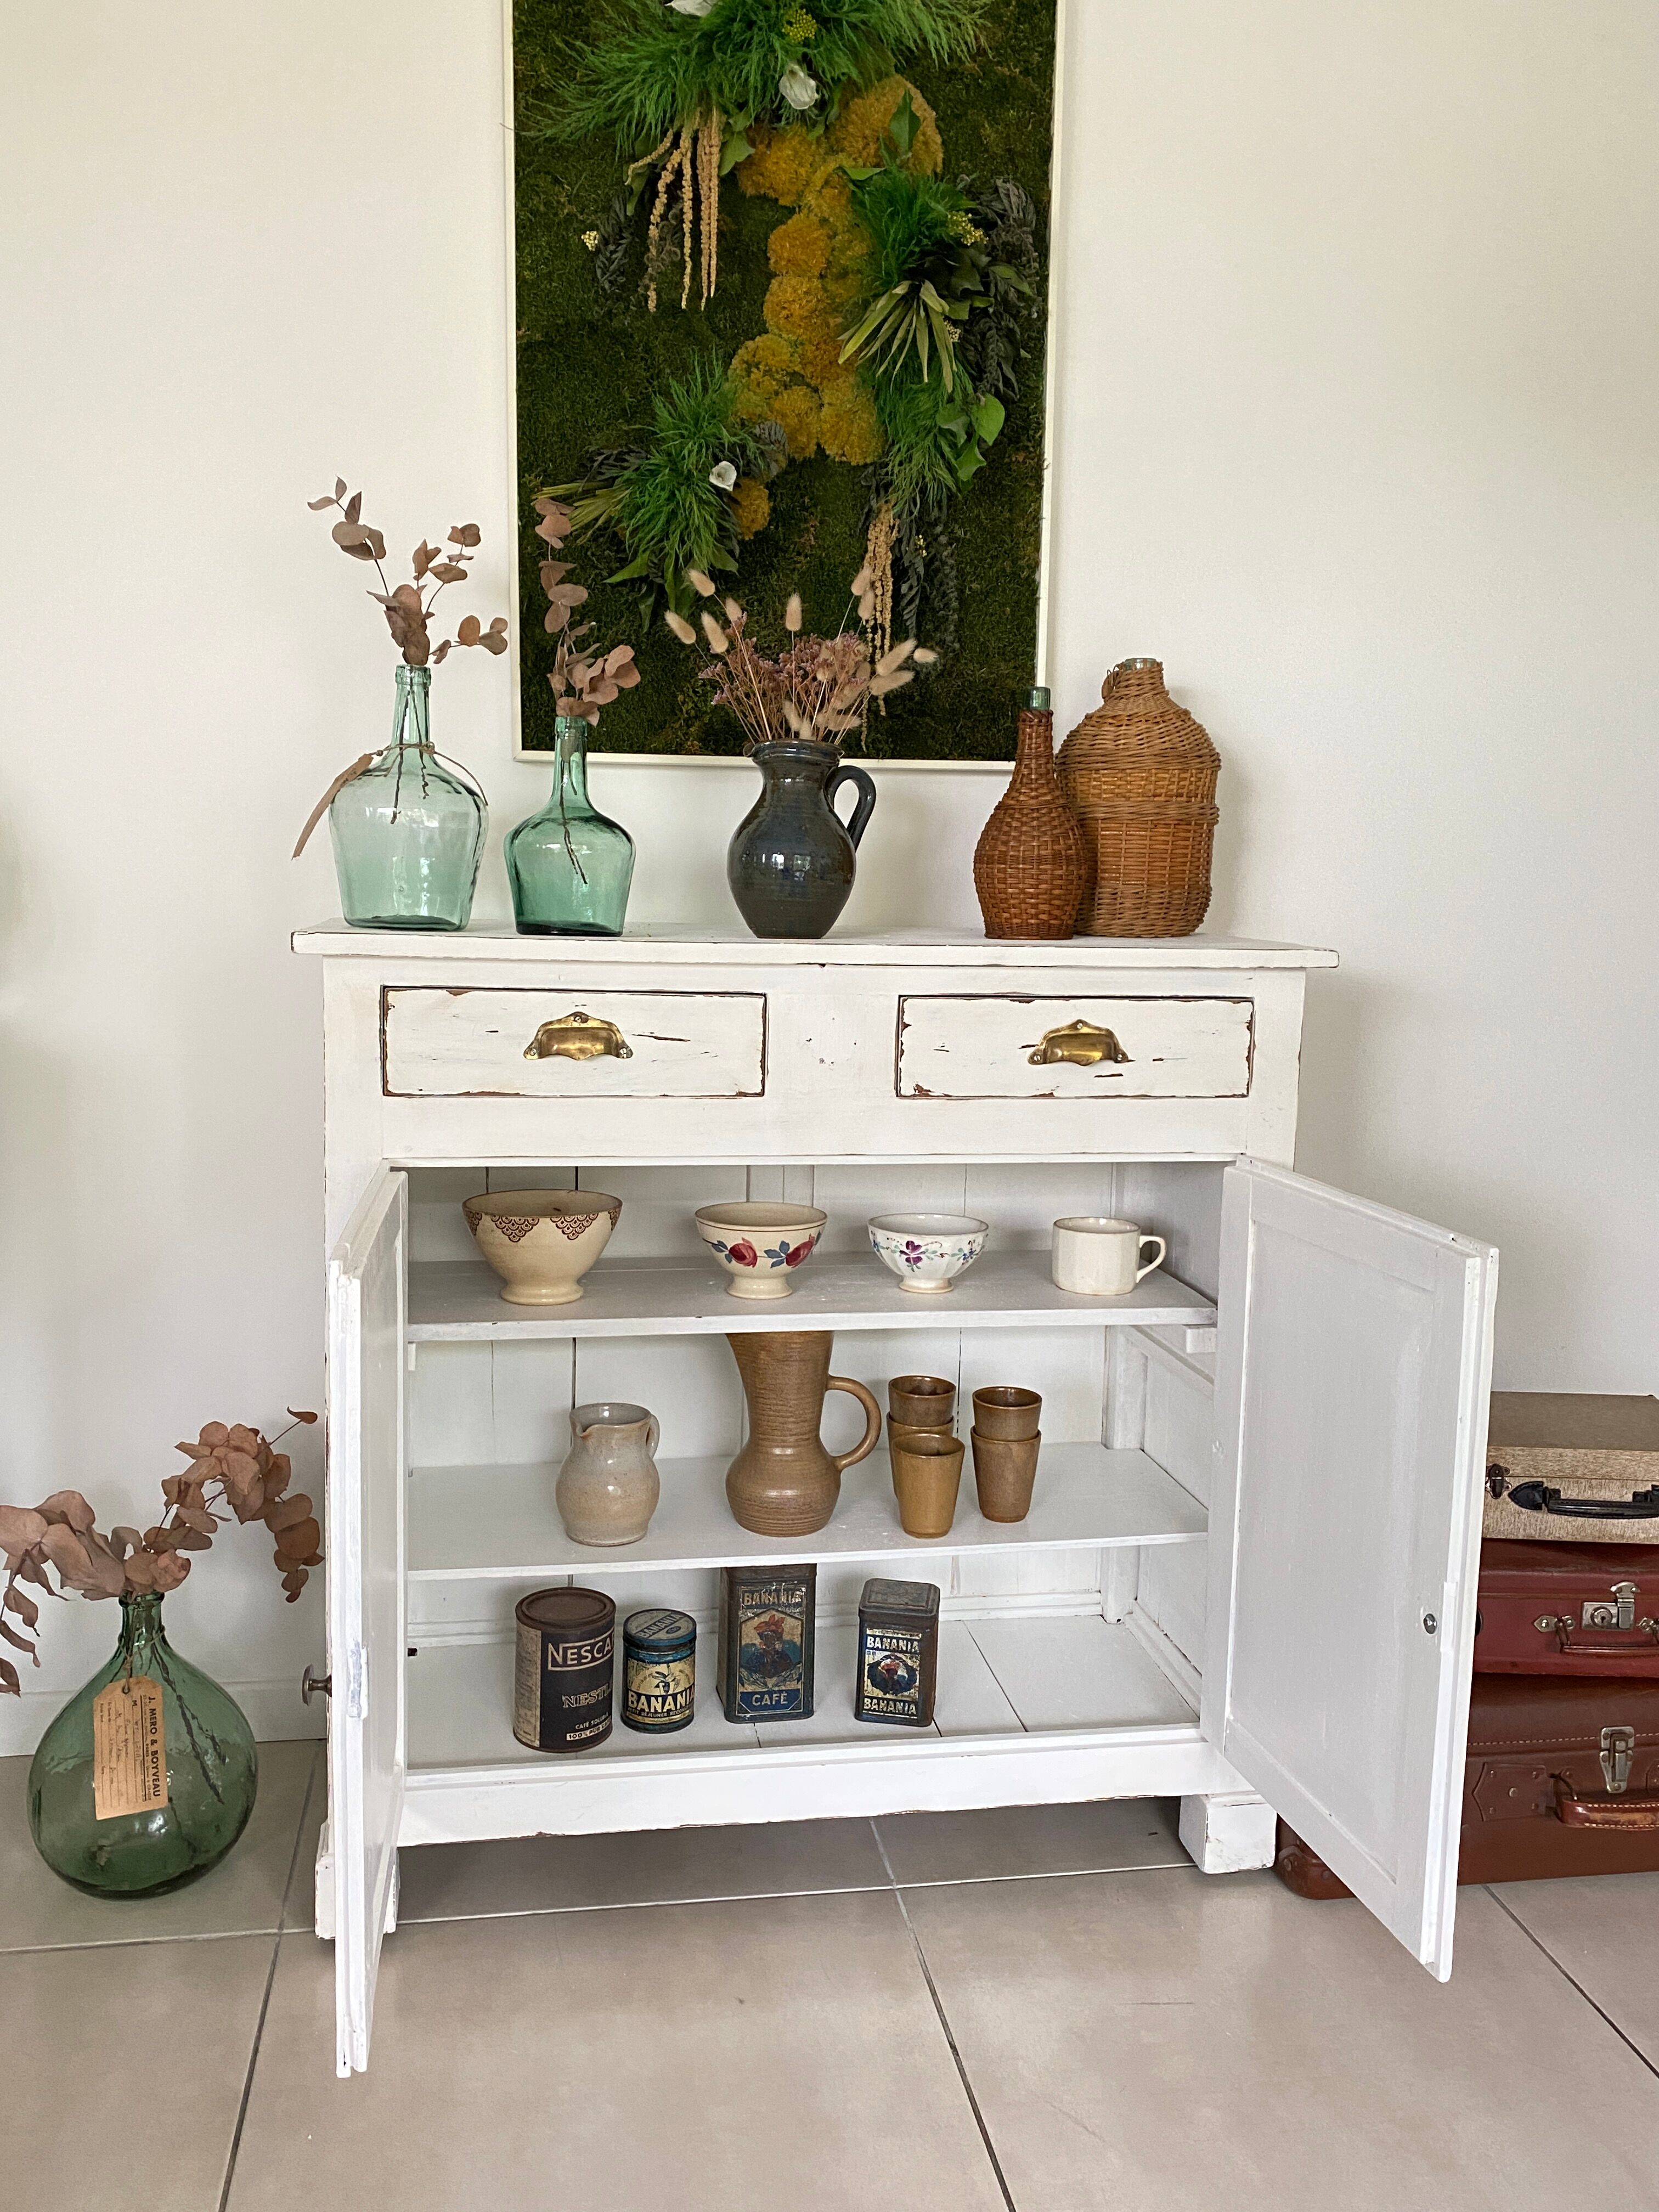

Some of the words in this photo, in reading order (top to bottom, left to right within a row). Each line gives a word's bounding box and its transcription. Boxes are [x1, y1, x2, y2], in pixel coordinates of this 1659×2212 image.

[636, 1613, 685, 1637] BANANIA
[867, 1636, 919, 1653] BANANIA
[628, 1683, 694, 1712] BANANIA
[752, 1691, 788, 1706] CAFÉ
[864, 1697, 916, 1715] BANANIA
[149, 1708, 158, 1735] MERO
[589, 1726, 600, 1735] PUR
[150, 1750, 161, 1797] BOYVEAU
